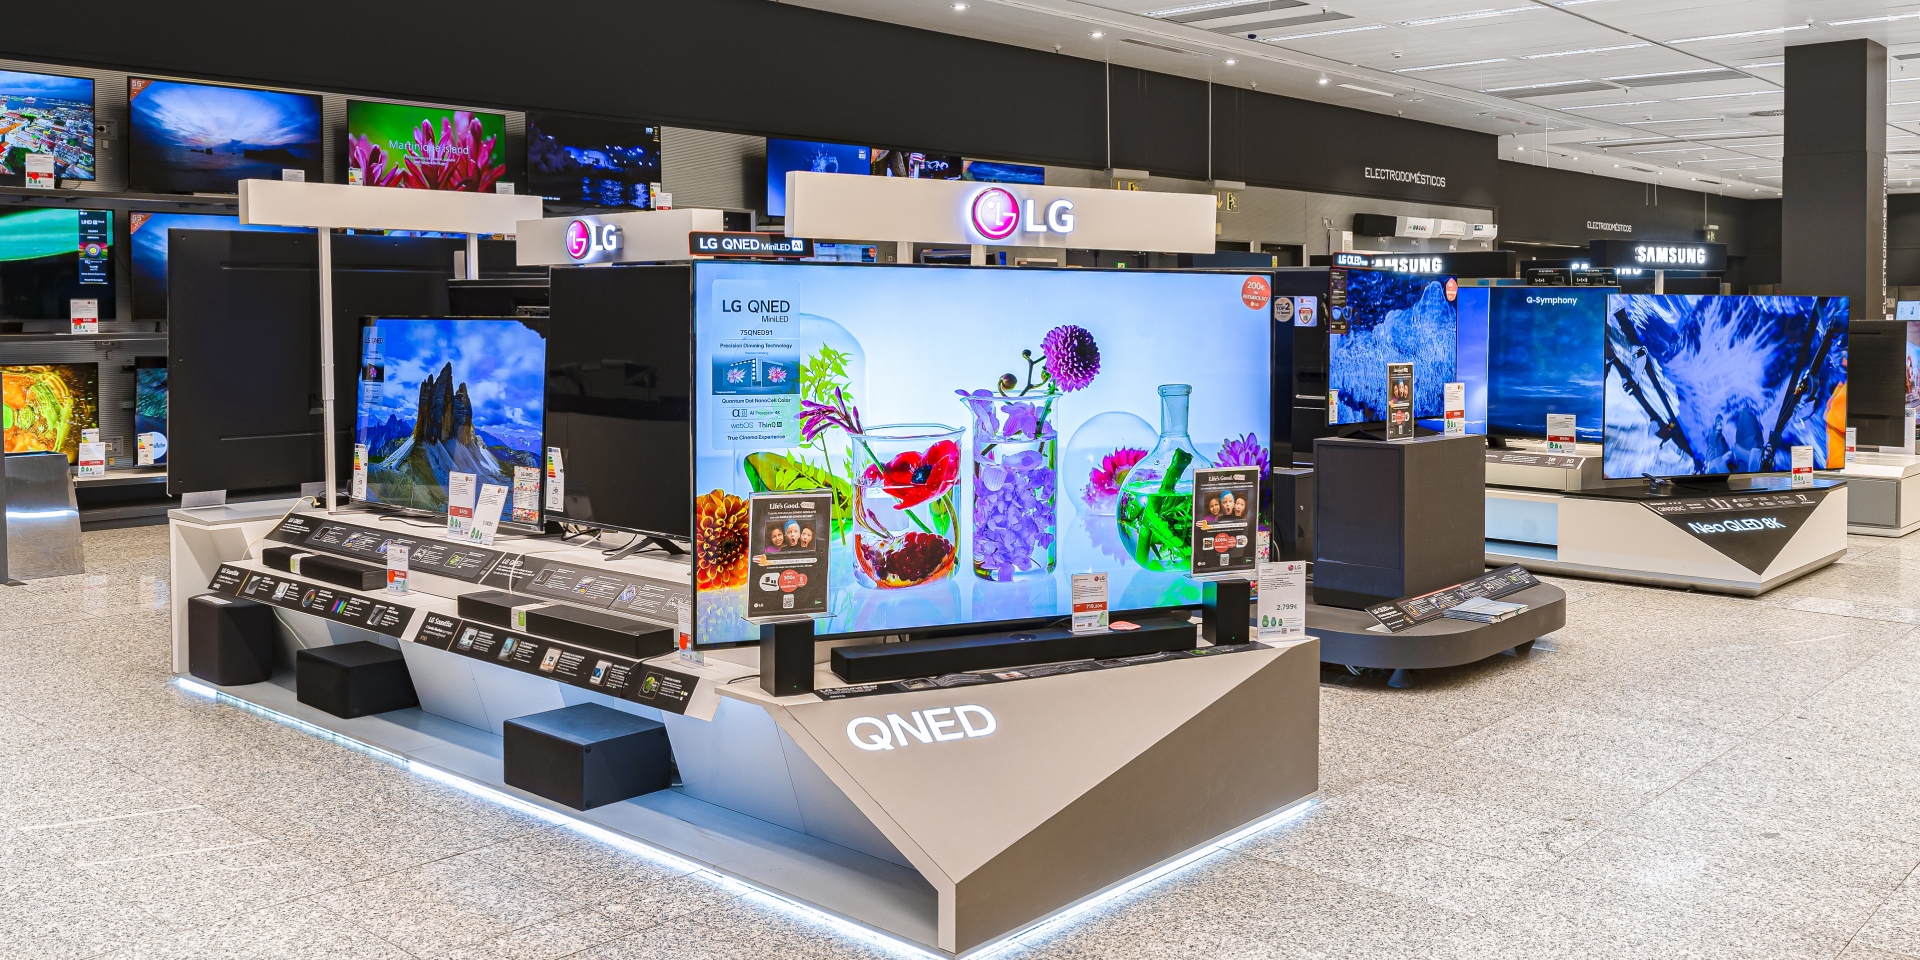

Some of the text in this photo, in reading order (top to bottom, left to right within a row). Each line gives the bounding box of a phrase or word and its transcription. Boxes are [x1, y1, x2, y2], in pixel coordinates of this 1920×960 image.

[389, 140, 468, 154] Martinique Island
[1364, 167, 1446, 187] ELECTRODOMÉSTICOS
[1024, 199, 1074, 234] LG
[1586, 220, 1632, 232] ELECTRODOMÉSTICOS
[592, 224, 616, 250] LG
[700, 238, 718, 249] LG
[722, 238, 759, 250] QNED
[761, 242, 790, 251] MiniLED
[1338, 255, 1346, 264] LG
[1347, 255, 1361, 264] OLED
[1637, 246, 1706, 264] SAMSUNG
[1247, 281, 1266, 290] 200€
[722, 300, 790, 313] LG QNED
[1526, 296, 1577, 306] Q-Symphony
[762, 315, 789, 323] MiniLED
[731, 421, 753, 429] webOS
[1687, 518, 1786, 534] Neo QLED 8K
[434, 618, 453, 628] SoundBar
[846, 704, 998, 751] QNED
